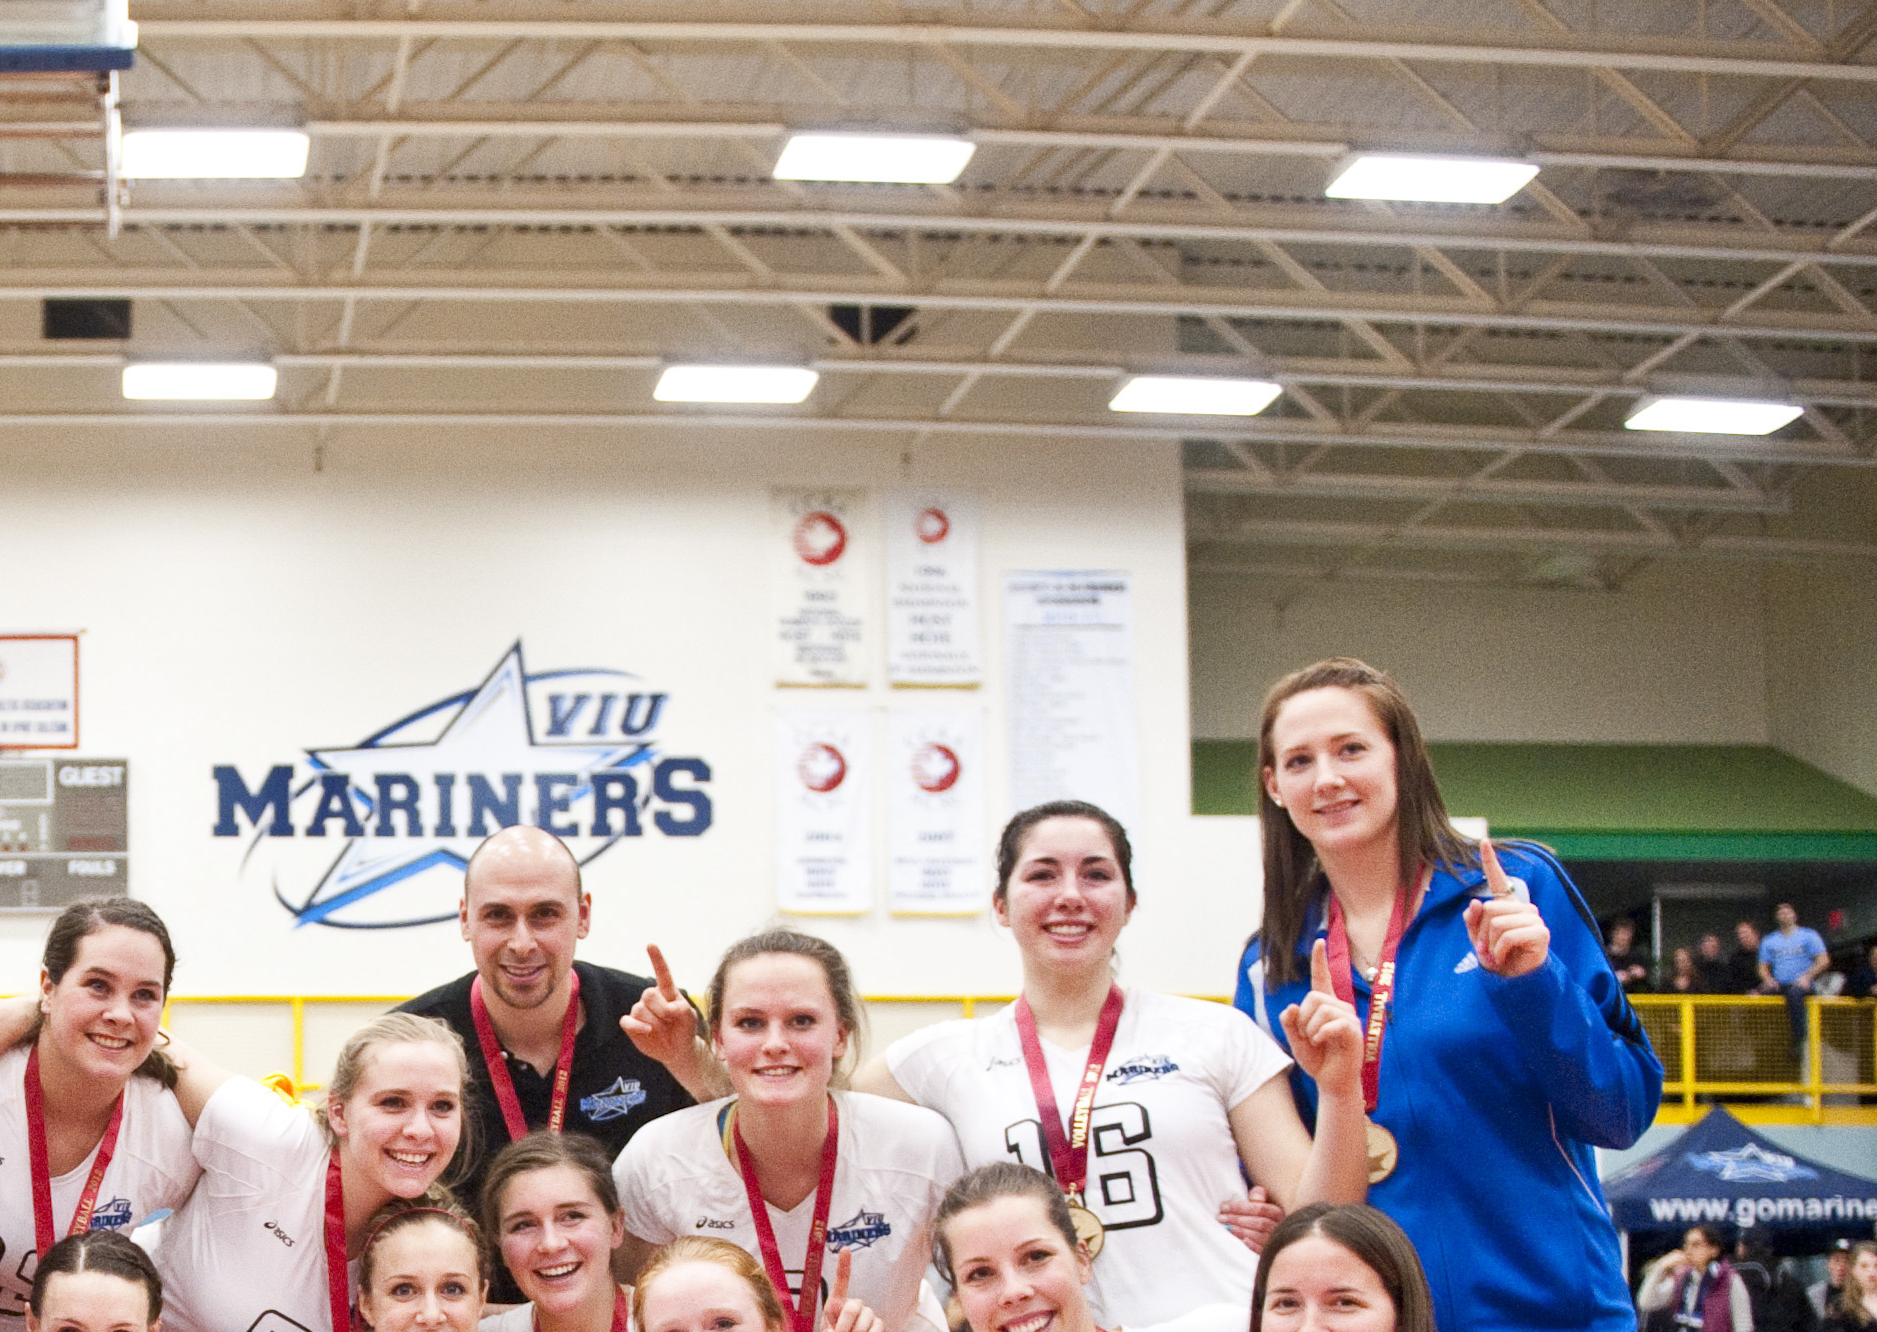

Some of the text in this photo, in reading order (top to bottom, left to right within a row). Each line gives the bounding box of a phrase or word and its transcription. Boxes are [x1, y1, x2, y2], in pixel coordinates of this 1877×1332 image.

[544, 692, 670, 737] VIU
[59, 765, 123, 786] GUEST
[212, 757, 713, 838] MARINERS
[68, 860, 115, 875] FOULS
[1365, 961, 1395, 1062] VOLLEYBALL 2012
[550, 1098, 563, 1131] YBALL
[1072, 1086, 1094, 1149] VOLLEYBALL
[1005, 1101, 1164, 1231] 16
[74, 1198, 93, 1235] EYBALL
[707, 1218, 735, 1230] asics
[274, 1226, 296, 1248] asics
